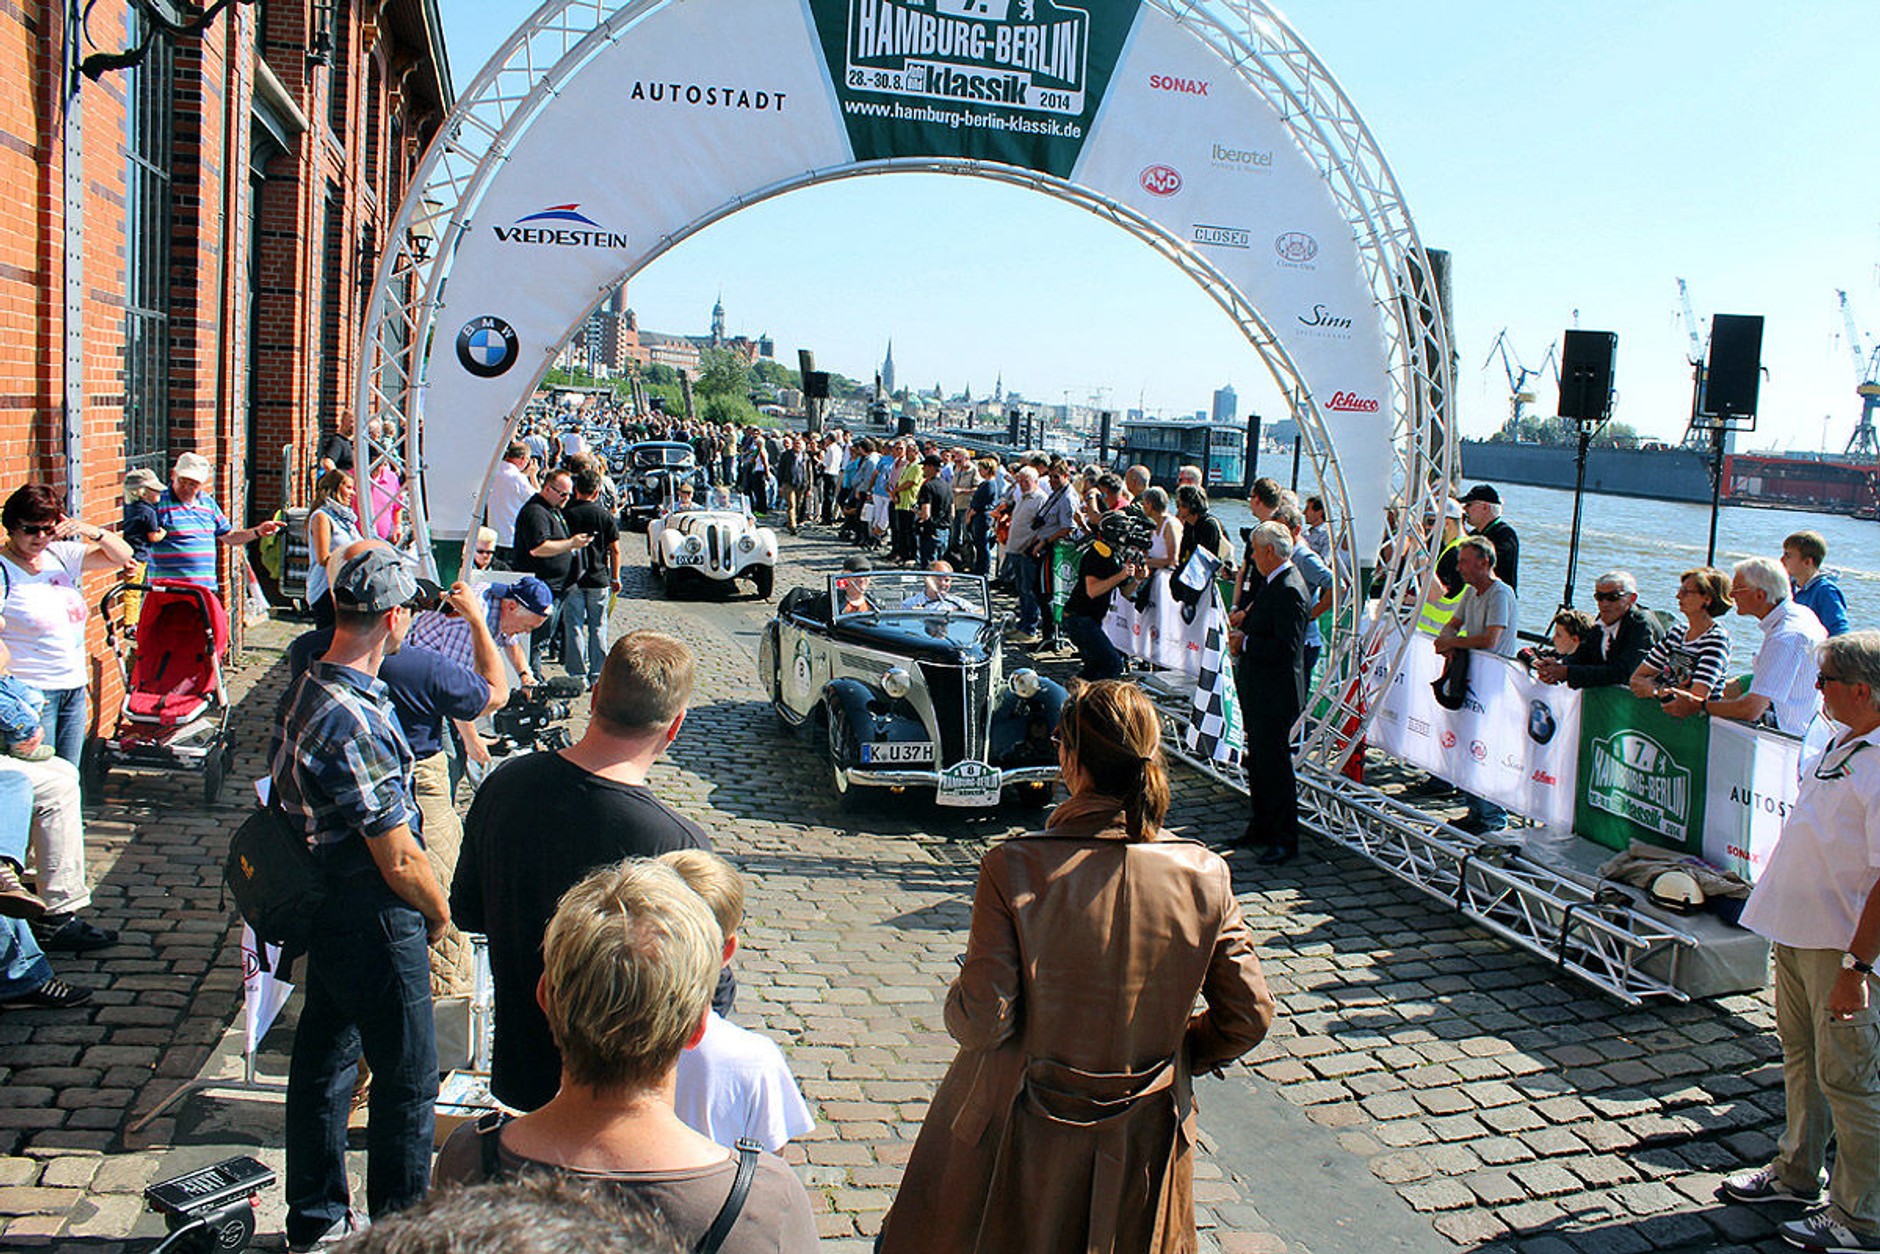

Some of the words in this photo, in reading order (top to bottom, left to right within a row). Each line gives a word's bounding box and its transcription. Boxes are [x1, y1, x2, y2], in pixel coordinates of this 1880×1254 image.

[858, 0, 1079, 84] HAMBURG-BERLIN
[849, 70, 904, 91] 28.-30.8.
[926, 65, 1028, 105] klassik
[1149, 75, 1209, 96] SONAX
[631, 81, 786, 111] AUTOSTADT
[1040, 92, 1070, 110] 2014
[845, 101, 1081, 138] www.hamburg-berlin-klassik.de
[1212, 144, 1273, 166] Iberotel
[492, 226, 627, 248] VREDESTEIN
[1195, 228, 1249, 245] CLOSED
[1298, 304, 1351, 329] Sinn
[462, 318, 514, 339] BMW
[1325, 390, 1379, 412] Schuco
[870, 746, 881, 761] K
[1634, 740, 1648, 767] 7.
[1594, 745, 1686, 820] HAMBURG-BERLIN
[1726, 845, 1759, 864] SONAX
